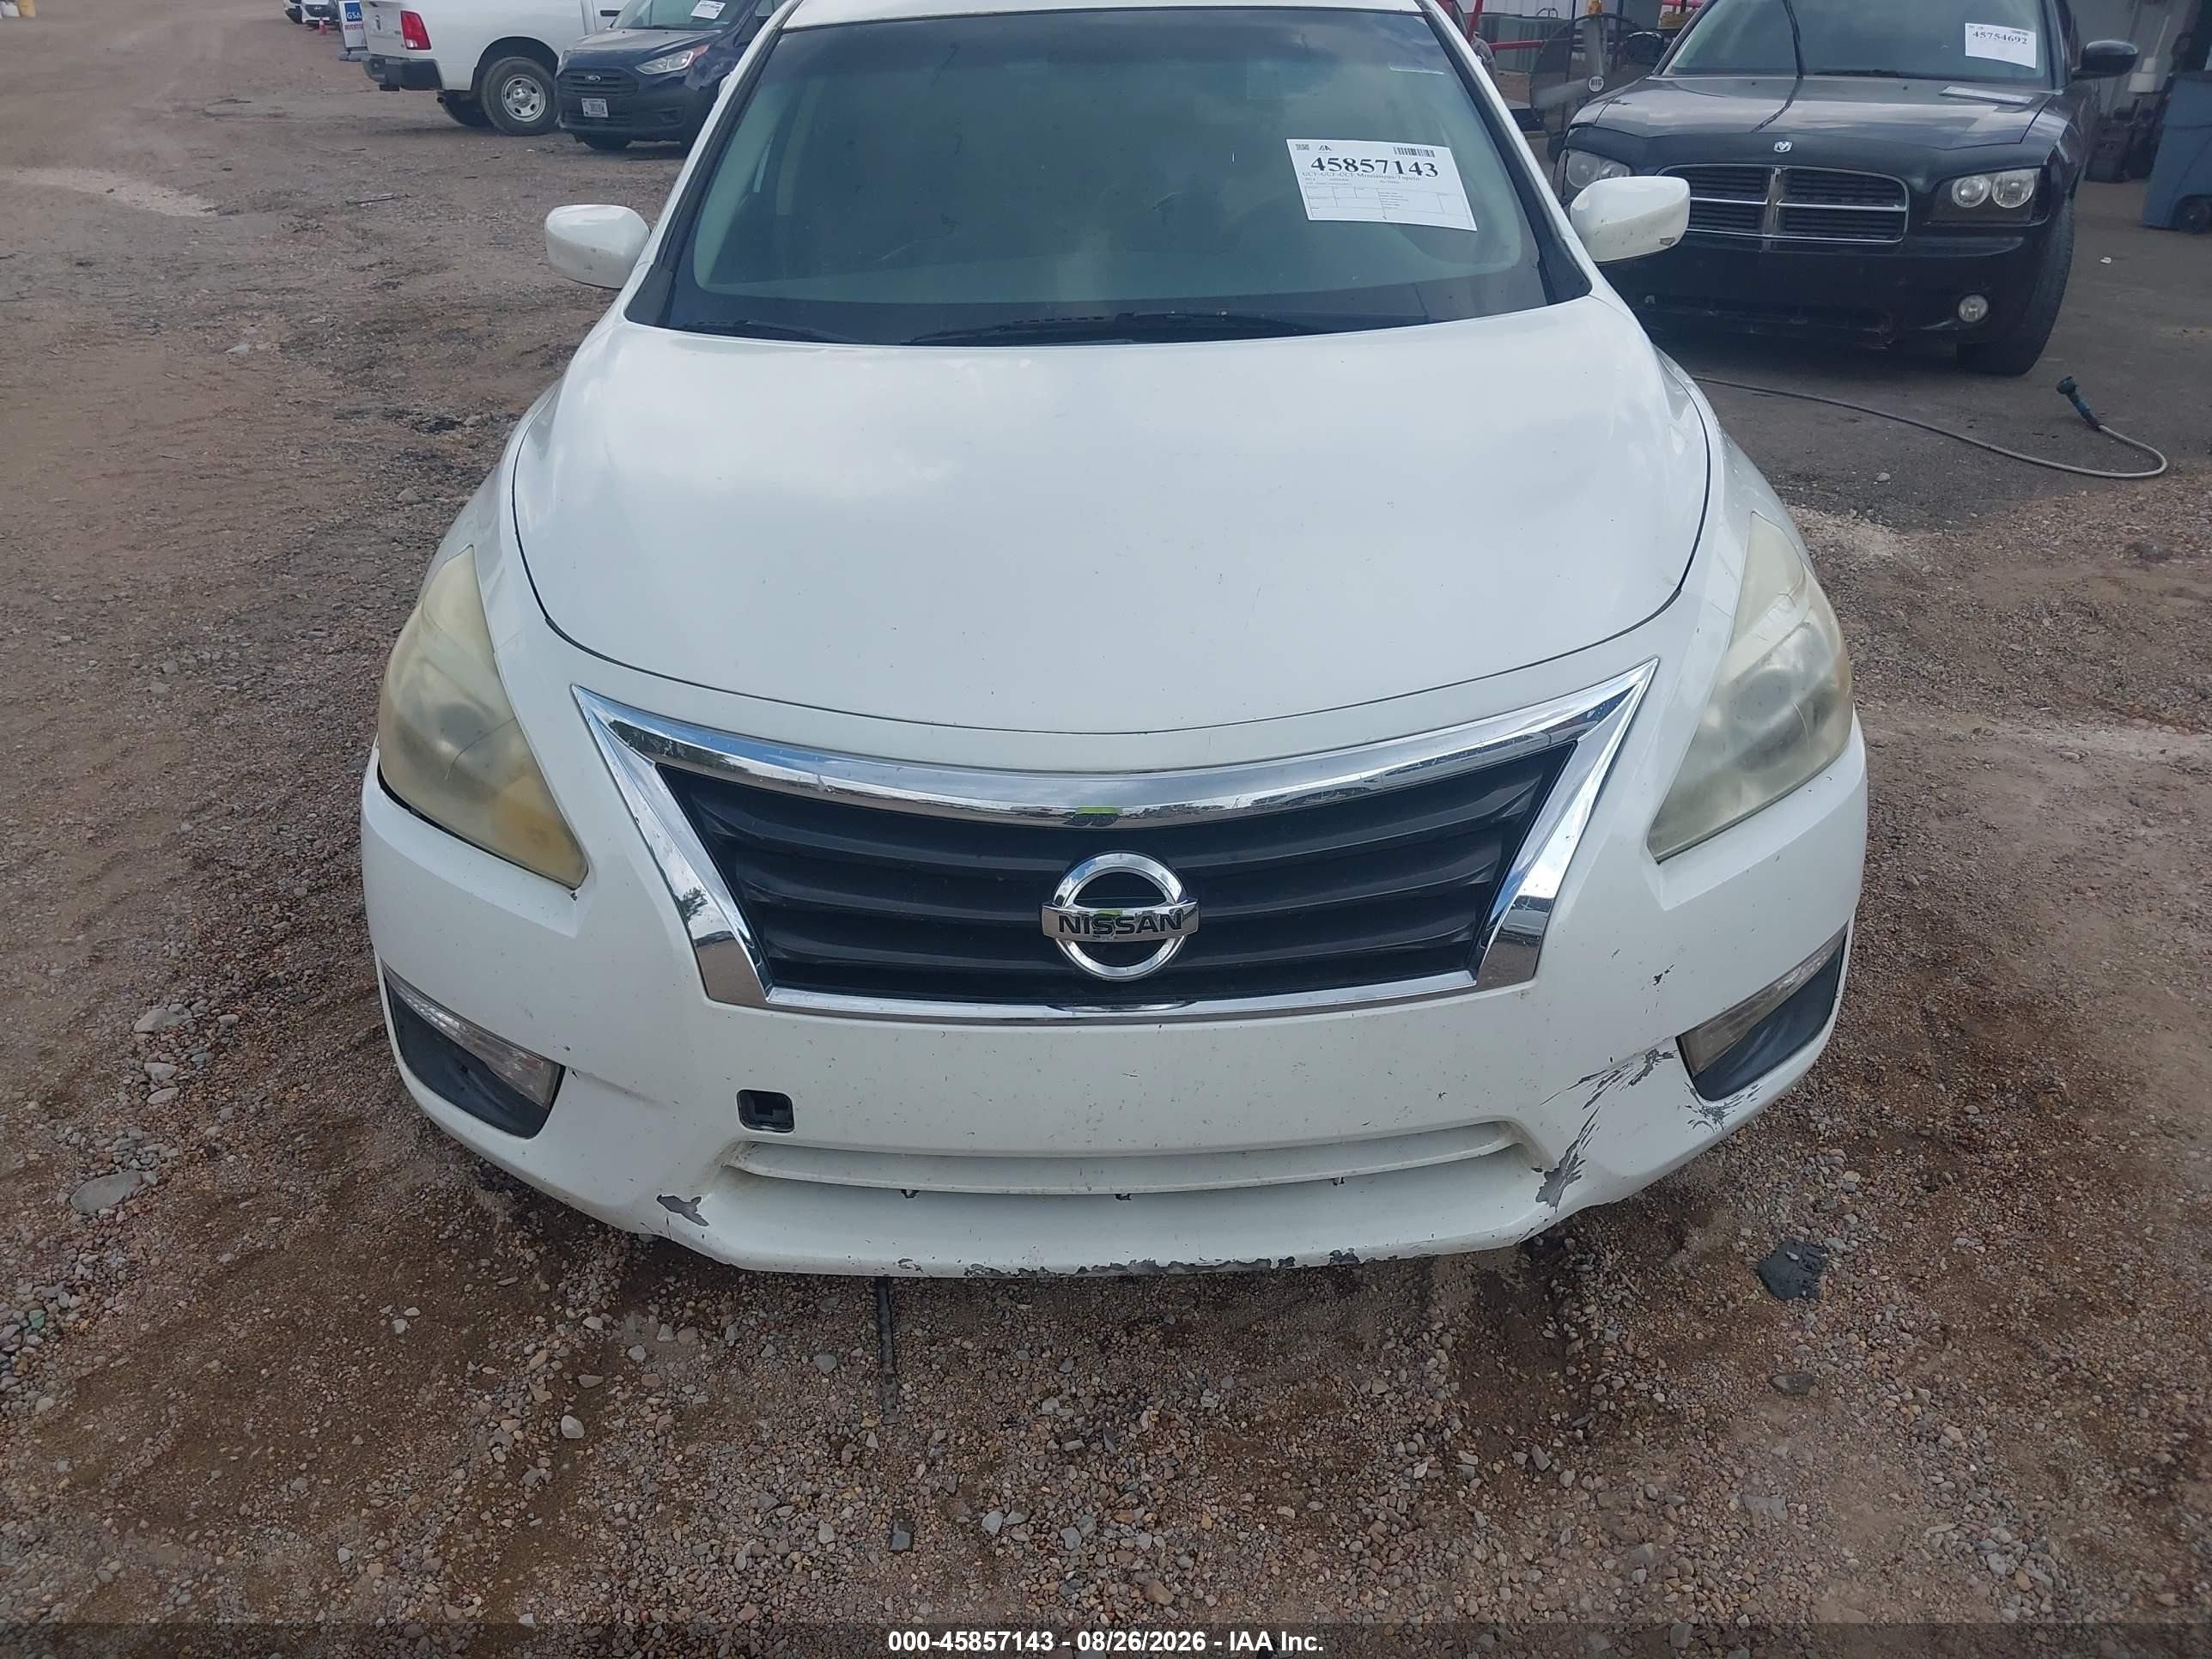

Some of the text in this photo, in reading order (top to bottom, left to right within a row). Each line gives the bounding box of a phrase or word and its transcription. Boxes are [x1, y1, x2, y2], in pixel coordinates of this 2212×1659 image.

[1972, 31, 2027, 45] 45754692
[1310, 157, 1438, 177] 45857143
[1058, 914, 1182, 935] NISSAN
